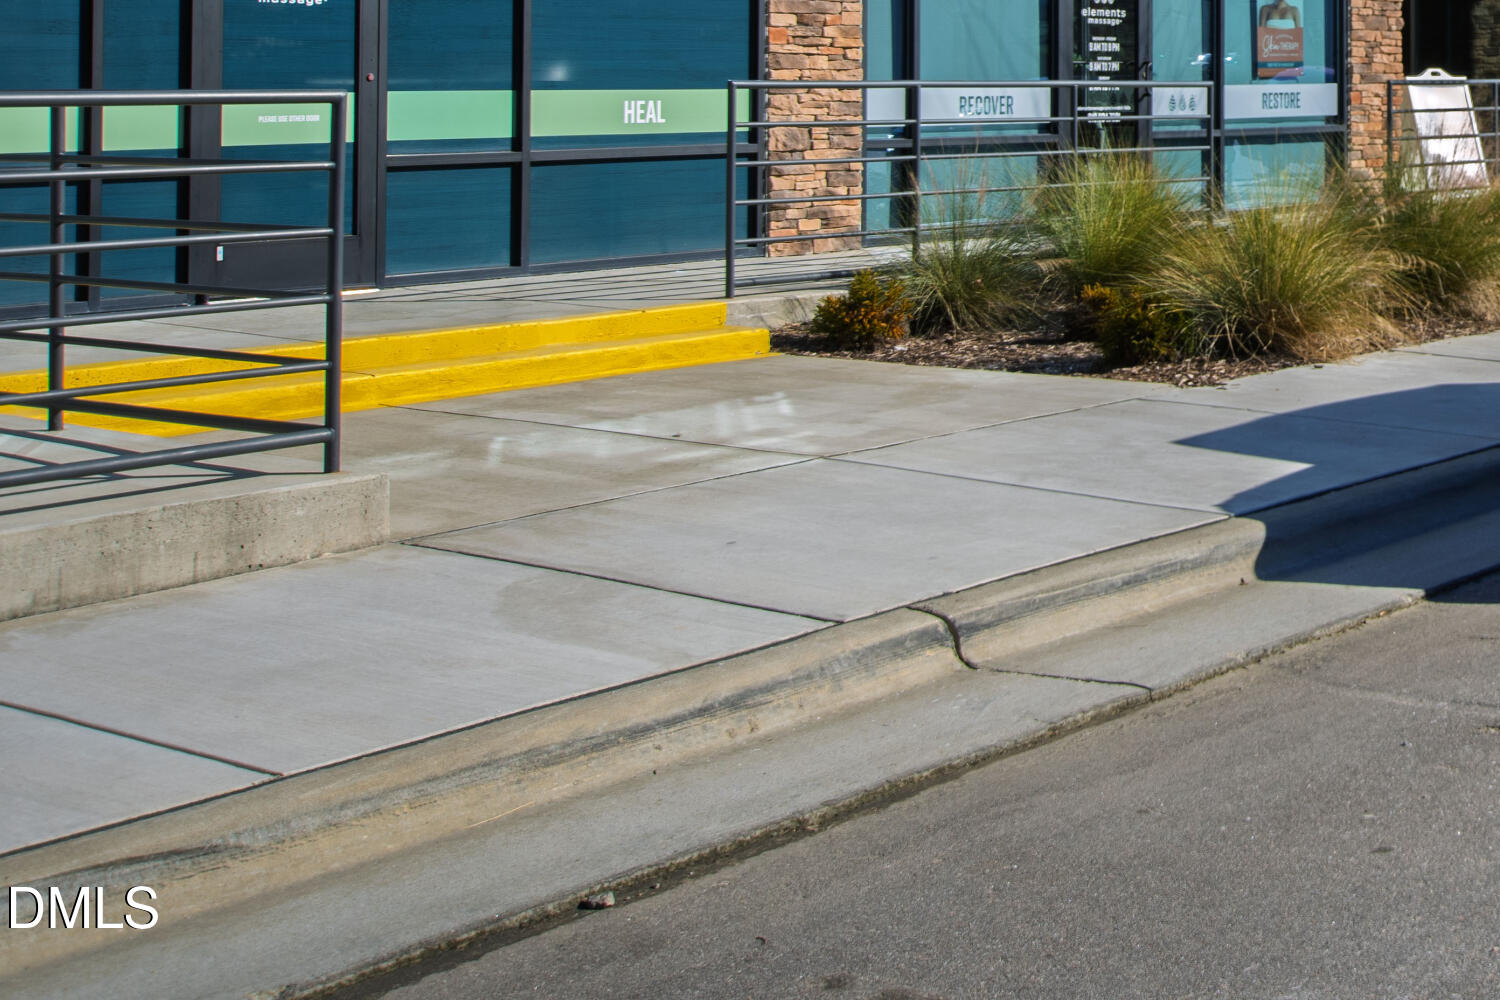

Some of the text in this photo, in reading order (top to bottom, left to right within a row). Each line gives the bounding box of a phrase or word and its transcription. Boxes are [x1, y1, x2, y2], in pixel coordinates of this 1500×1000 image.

[1081, 7, 1127, 18] elements
[959, 95, 1014, 115] RECOVER
[1262, 92, 1302, 110] RESTORE
[624, 100, 667, 124] HEAL
